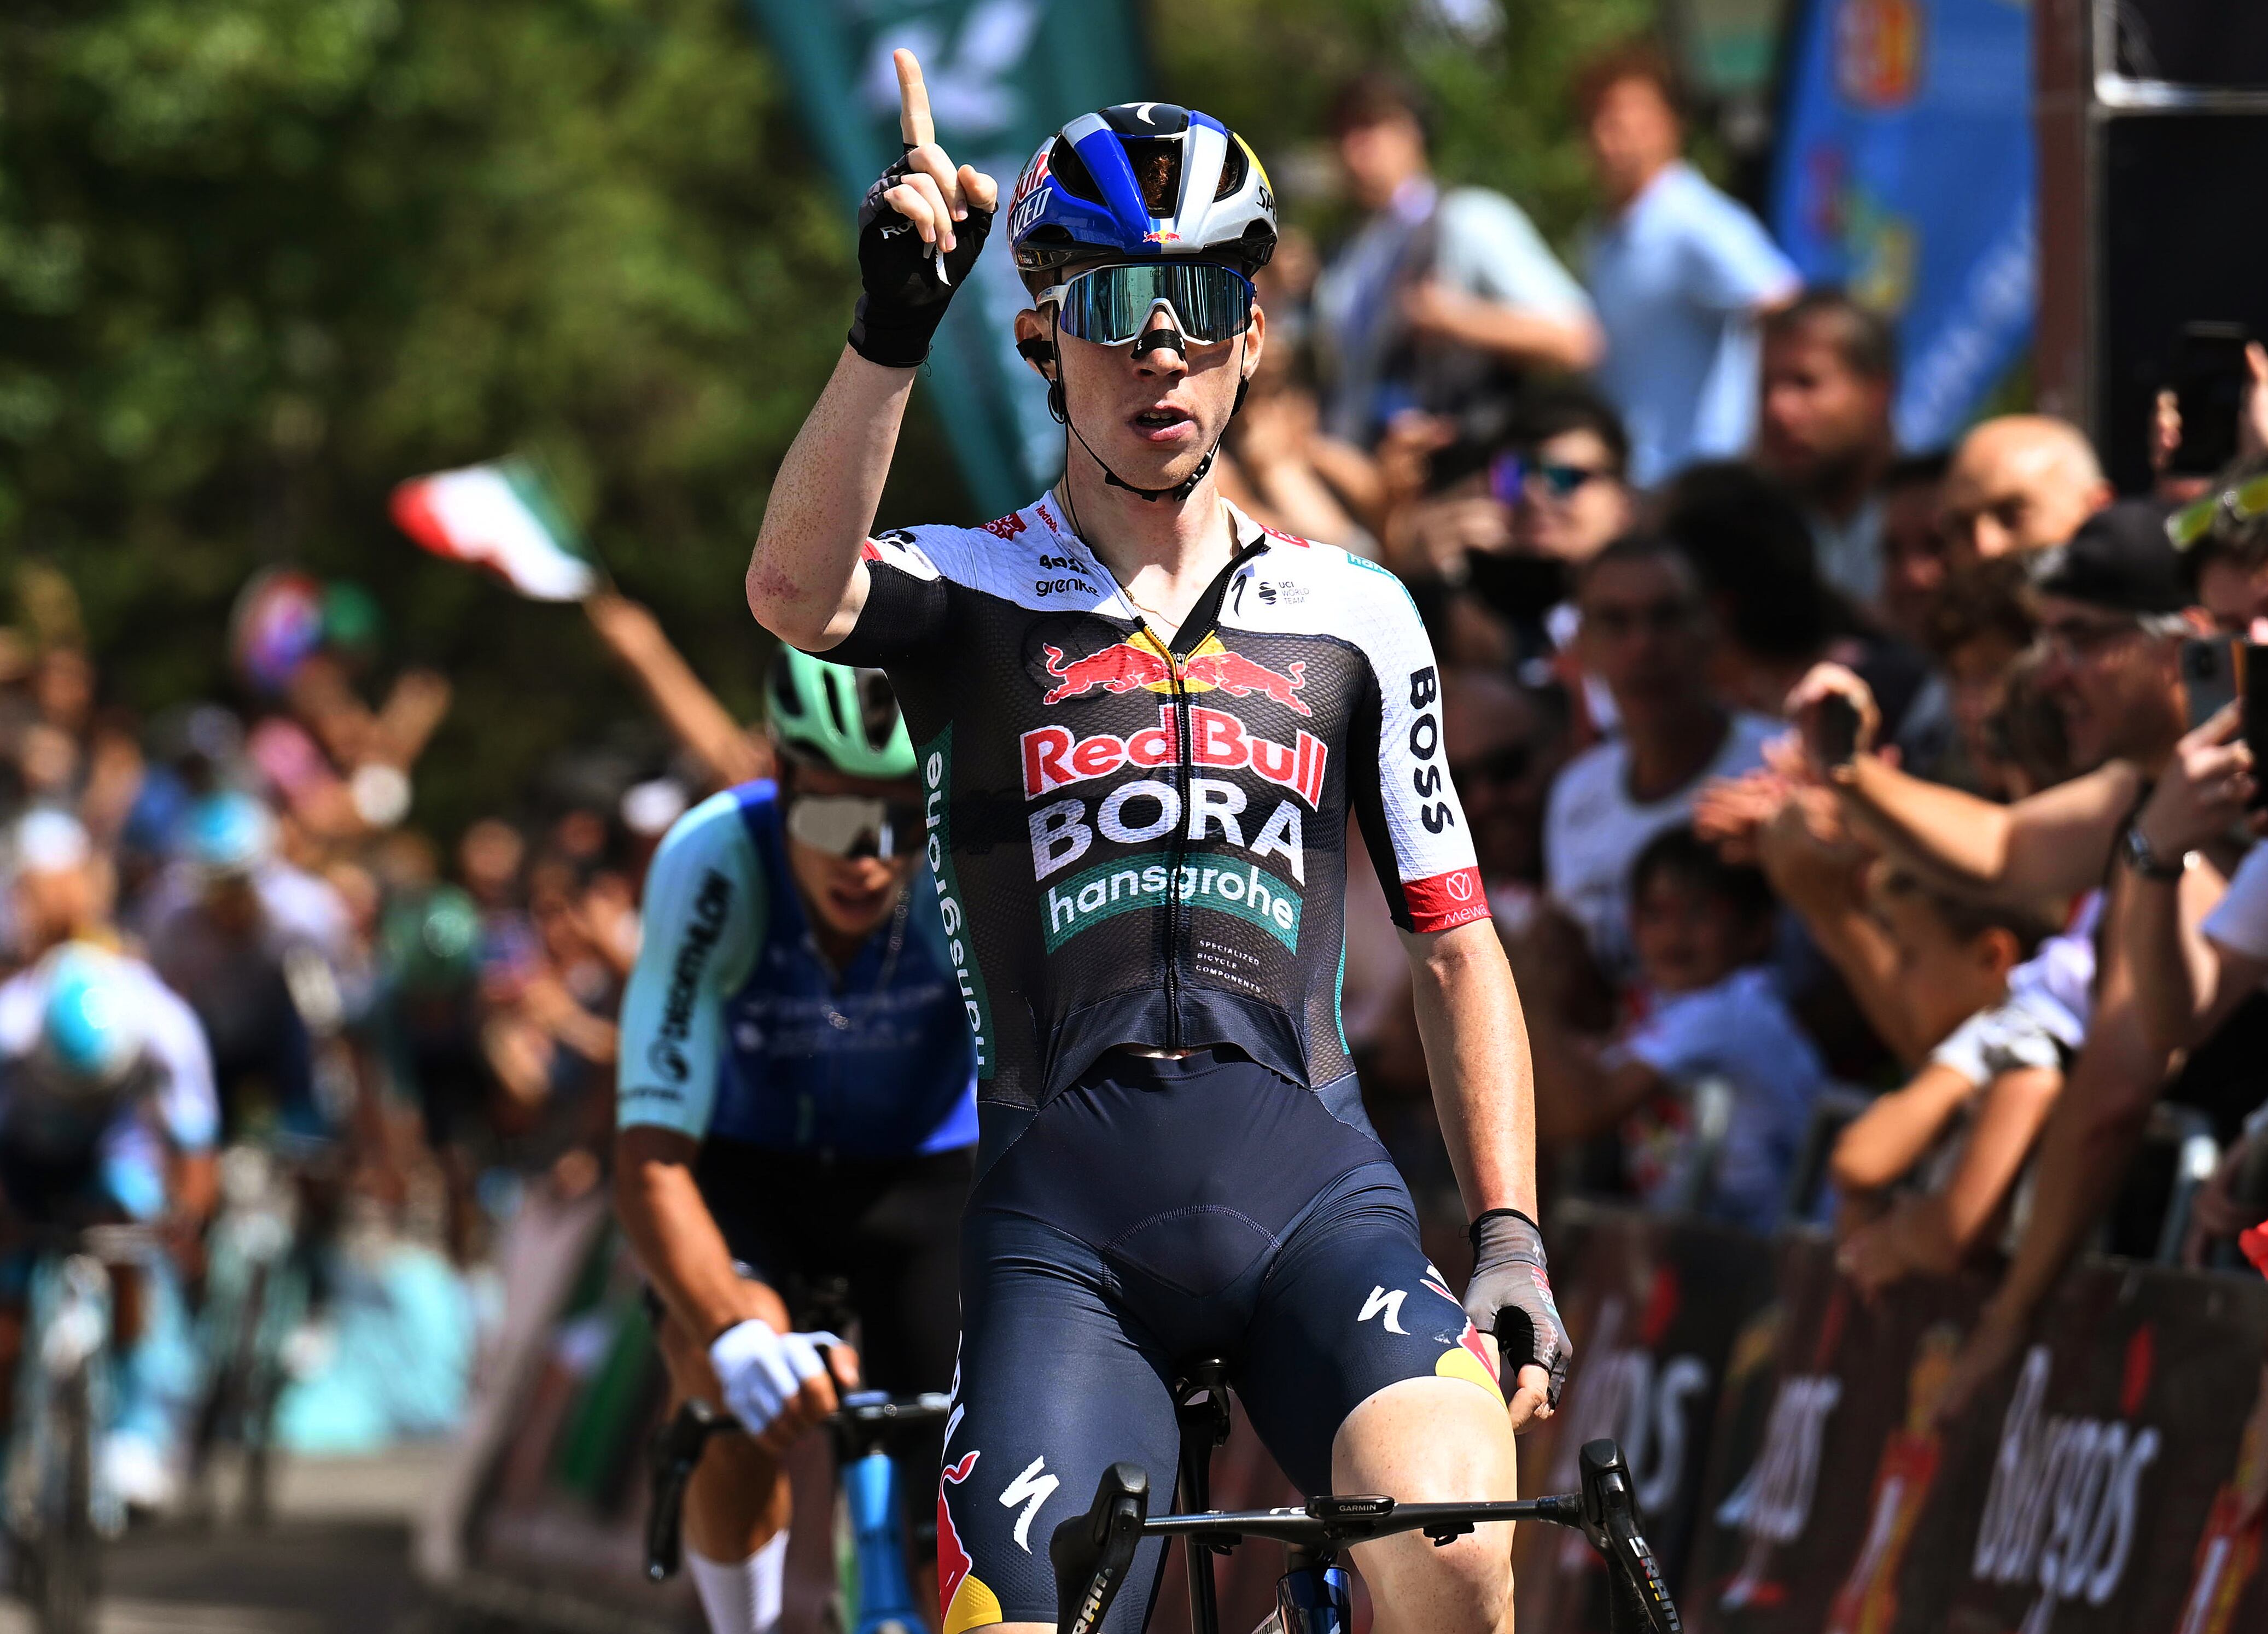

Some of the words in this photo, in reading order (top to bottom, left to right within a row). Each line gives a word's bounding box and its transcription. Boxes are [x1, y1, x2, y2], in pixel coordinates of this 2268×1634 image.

[1281, 588, 1310, 597] WORLD
[1284, 596, 1306, 605] TEAM
[1410, 666, 1455, 834] BOSS
[1028, 778, 1305, 887] BORA
[1048, 865, 1294, 934] hansgrohe
[1444, 903, 1488, 926] mewa
[1197, 952, 1238, 970] BICYCLE
[1199, 939, 1260, 966] SPECIALIZED
[1195, 964, 1261, 994] COMPONENTS
[1339, 1504, 1377, 1512] GARMIN
[1071, 1572, 1107, 1634] RAM
